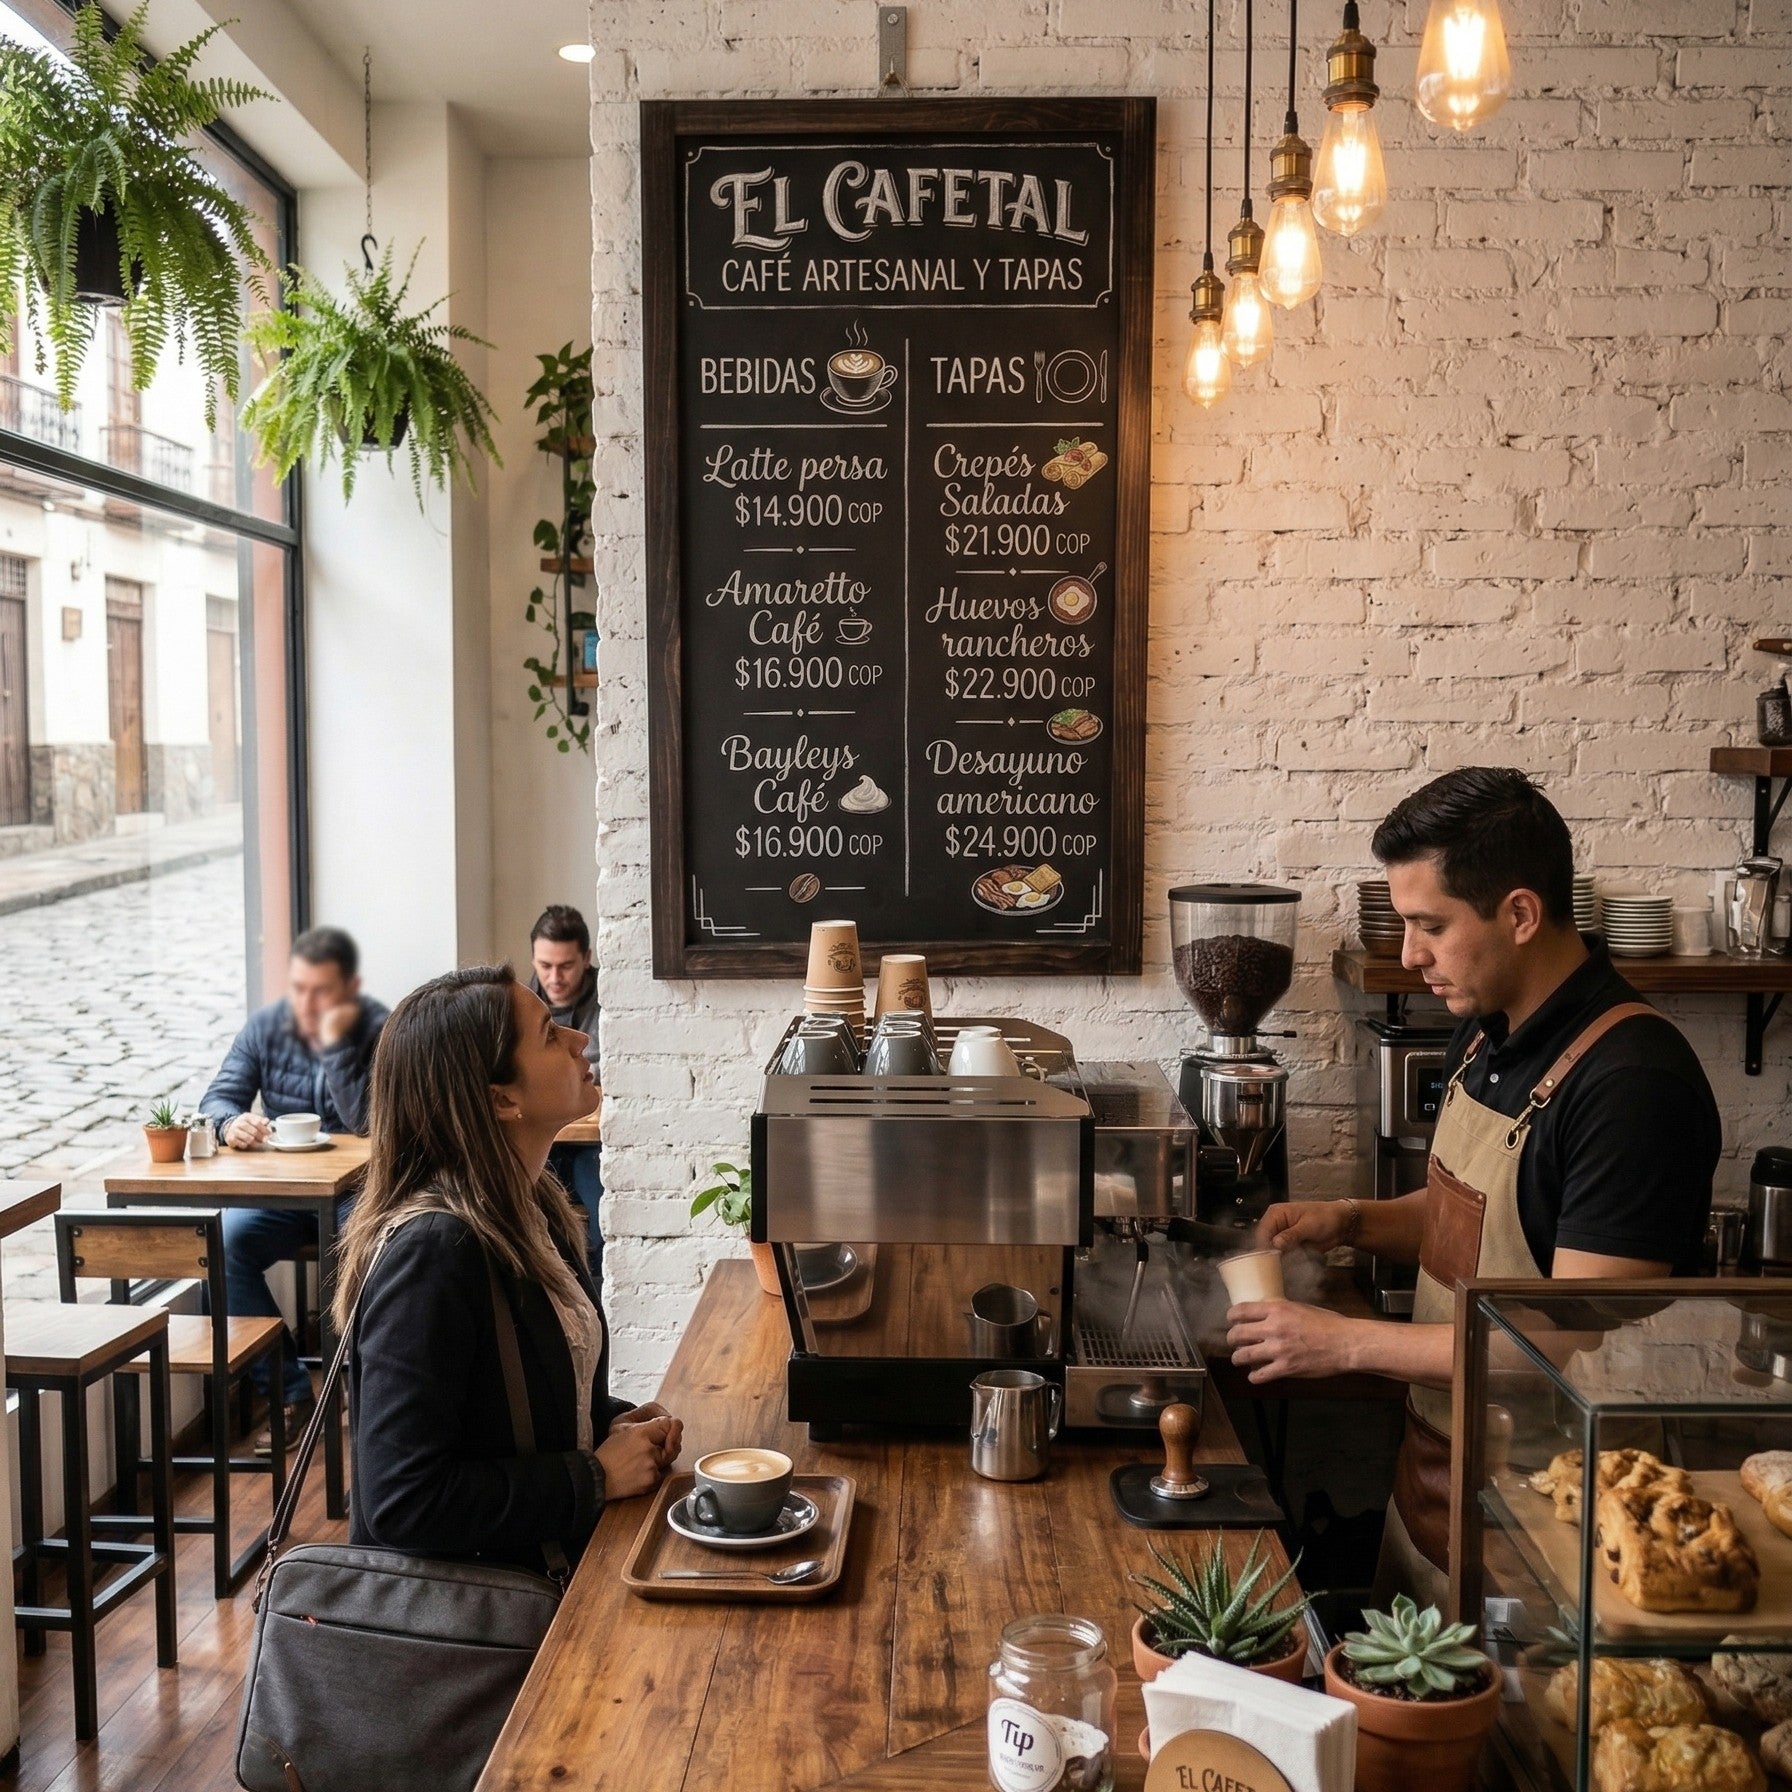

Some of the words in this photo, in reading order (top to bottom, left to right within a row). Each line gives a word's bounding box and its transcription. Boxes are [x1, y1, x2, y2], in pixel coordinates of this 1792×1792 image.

[709, 165, 809, 252] EL
[821, 159, 1090, 247] CAFETAL
[721, 251, 792, 292] CAFÉ
[802, 258, 966, 292] ARTESANAL
[972, 258, 991, 291] Y
[998, 257, 1084, 291] TAPAS
[701, 357, 816, 395] BEBIDAS
[930, 356, 1025, 395] TAPAS
[702, 444, 793, 489] Latte
[797, 454, 888, 492] persa
[933, 443, 1037, 487] Crepés
[735, 493, 843, 528] $14.900
[848, 502, 883, 524] COP
[939, 482, 1070, 517] Saladas
[945, 522, 1051, 557] $21.900
[1055, 533, 1091, 555] COP
[705, 569, 872, 609] Amaretto
[925, 585, 1046, 625] Huevos
[748, 609, 824, 655] Café
[941, 623, 1095, 658] rancheros
[734, 655, 843, 690] $16.900
[848, 664, 883, 686] COP
[945, 667, 1056, 700] $22.900
[1061, 676, 1096, 698] COP
[720, 734, 861, 782] Bayleys
[925, 738, 1089, 788] Desayuno
[753, 778, 831, 823] Café
[936, 784, 1100, 815] americano
[734, 824, 843, 859] $16.900
[849, 834, 883, 856] COP
[945, 824, 1057, 859] $24.900
[1062, 834, 1097, 856] COP
[1001, 1719, 1034, 1756] Tip
[1175, 1765, 1198, 1789] EL
